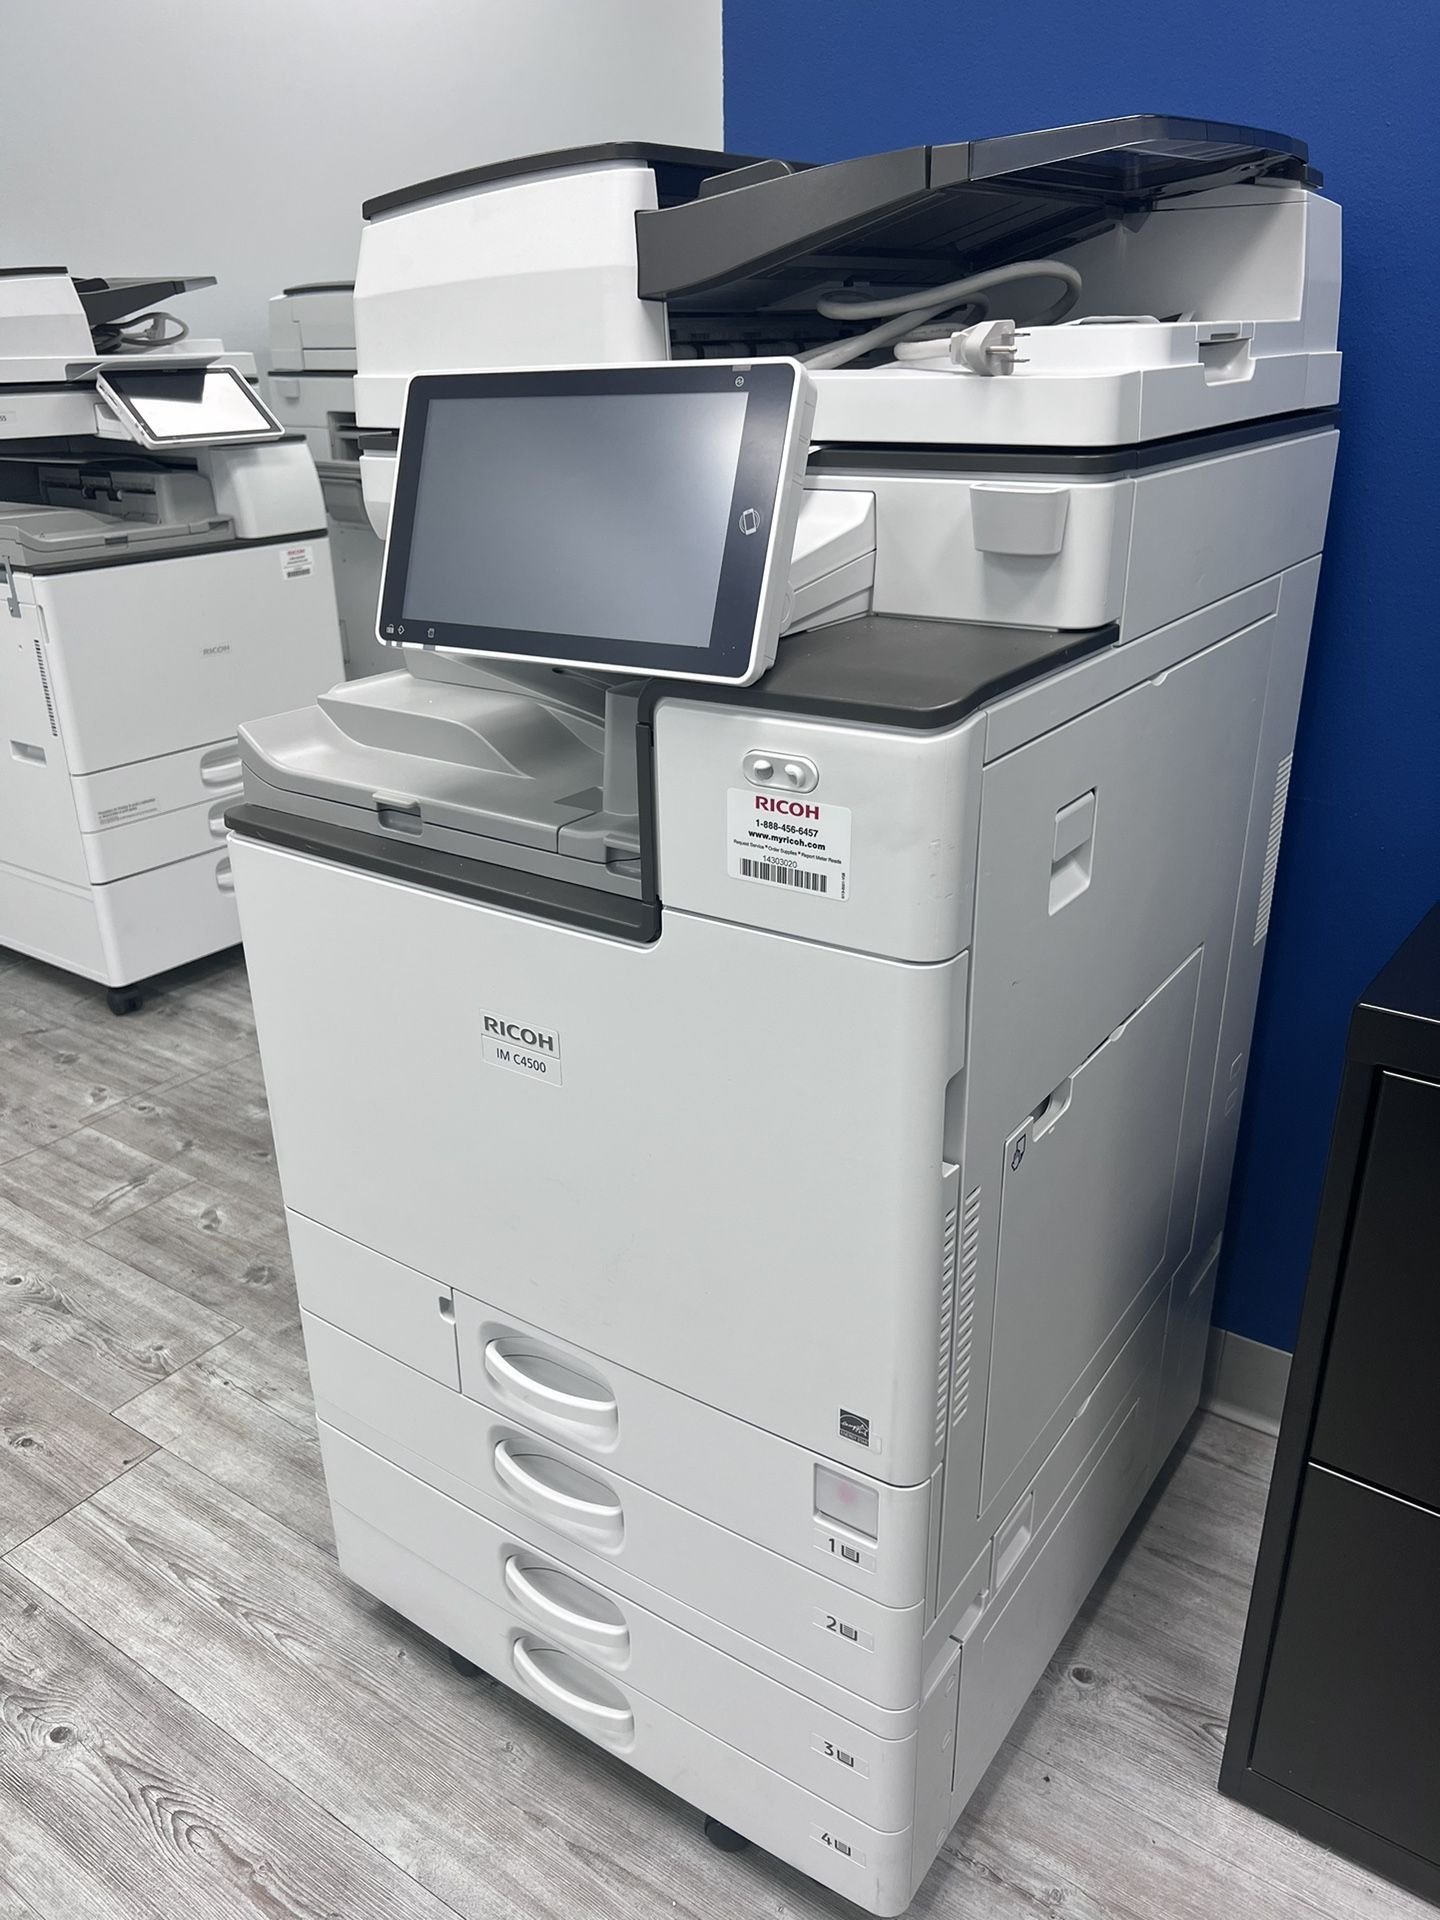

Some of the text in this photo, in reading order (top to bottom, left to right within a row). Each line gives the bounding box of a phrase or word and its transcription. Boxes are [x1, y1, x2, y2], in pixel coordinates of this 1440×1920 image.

[755, 795, 819, 820] RICOH
[755, 819, 819, 837] 1-888-456-6457
[748, 830, 826, 851] www.myricoh.com
[763, 855, 798, 868] 14303020
[484, 1015, 553, 1052] RICOH
[496, 1047, 546, 1073] IM C4500
[829, 1538, 835, 1552] 1
[826, 1615, 837, 1632] 2
[824, 1741, 834, 1757] 3
[821, 1832, 832, 1846] 4
